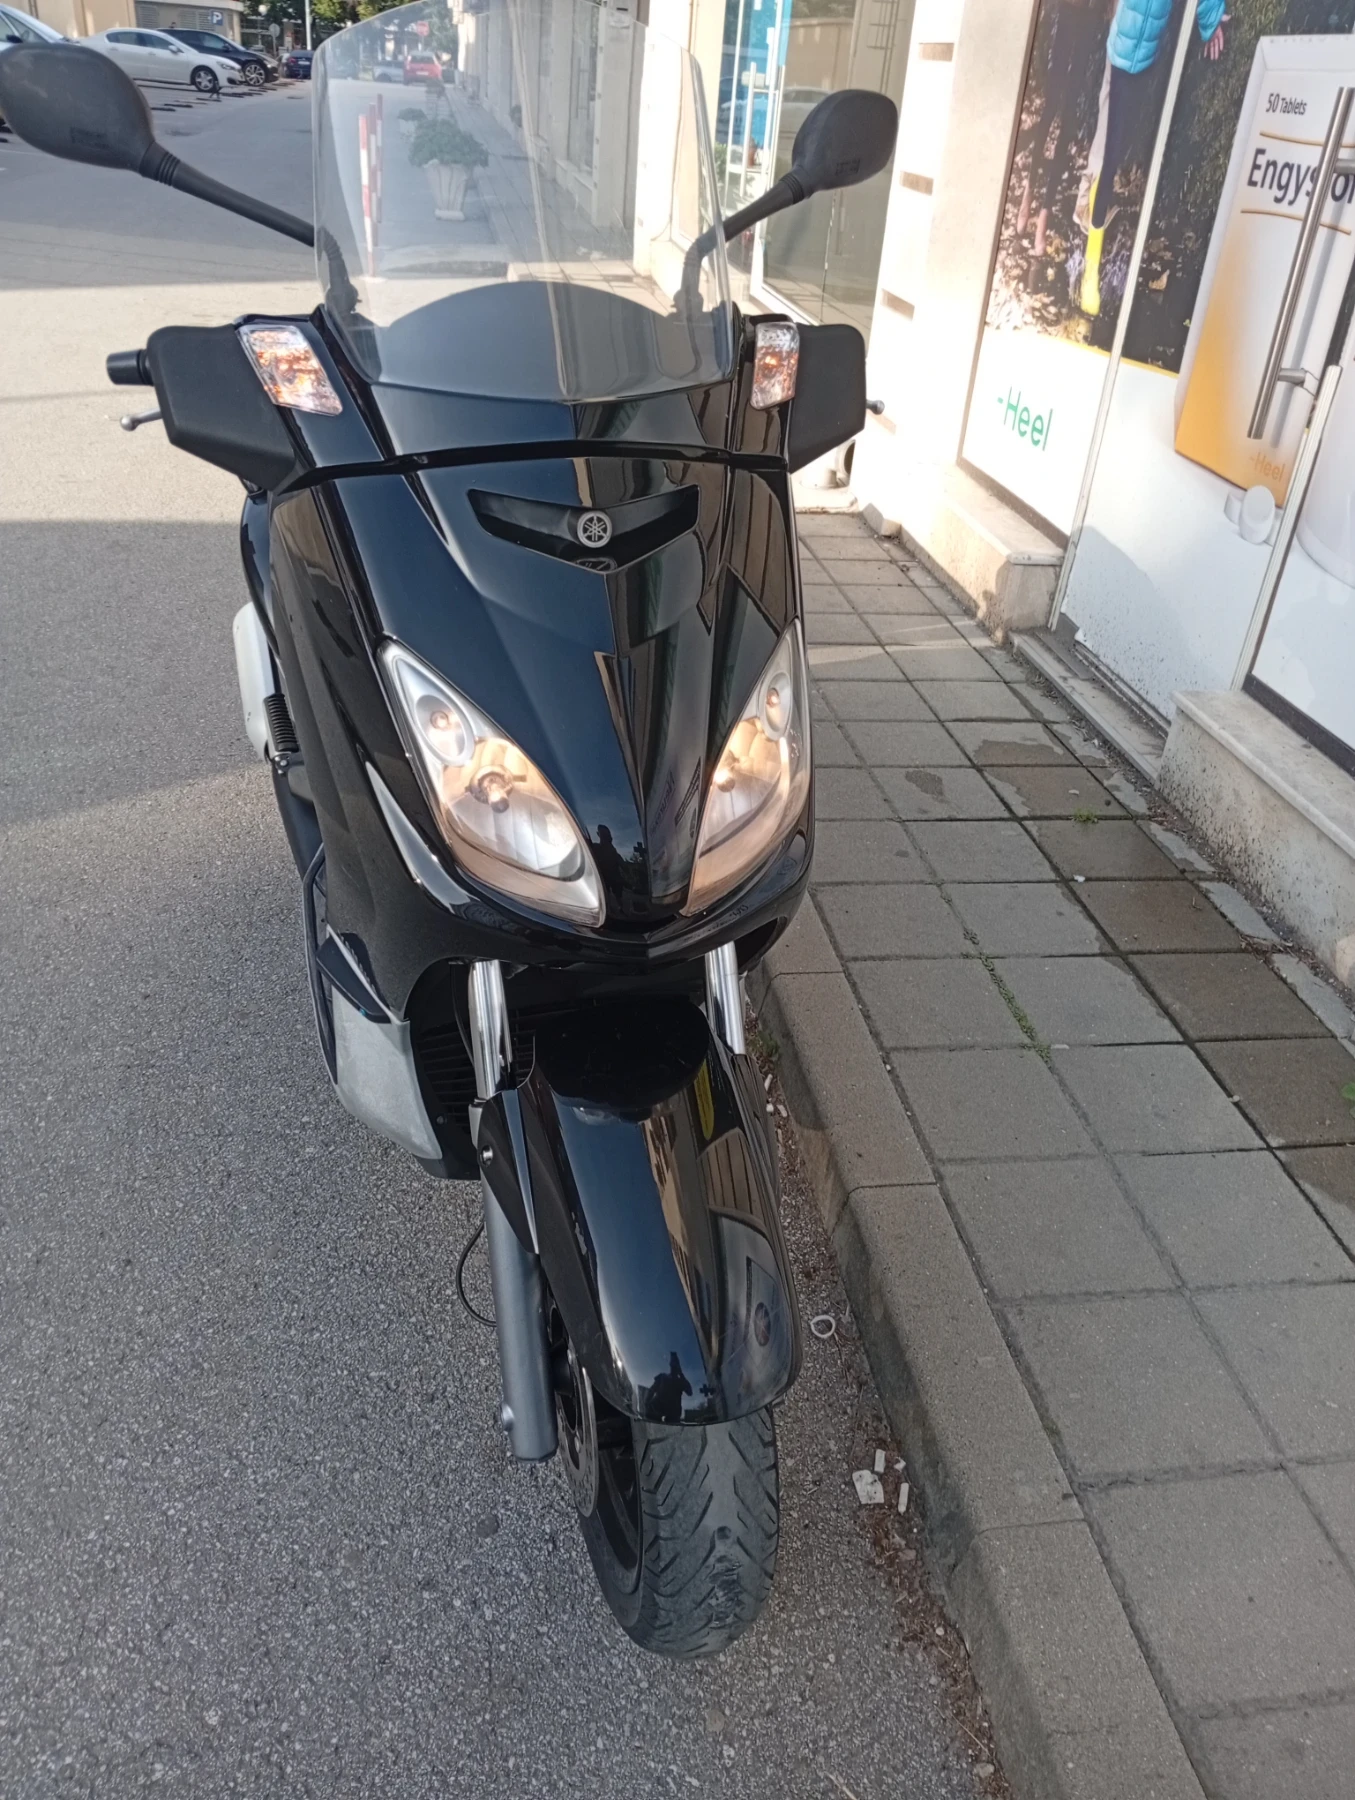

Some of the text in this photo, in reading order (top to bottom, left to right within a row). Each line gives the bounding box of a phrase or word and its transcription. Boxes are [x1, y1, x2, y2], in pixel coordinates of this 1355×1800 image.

[213, 11, 222, 24] P
[1266, 93, 1307, 115] 50 Tablets
